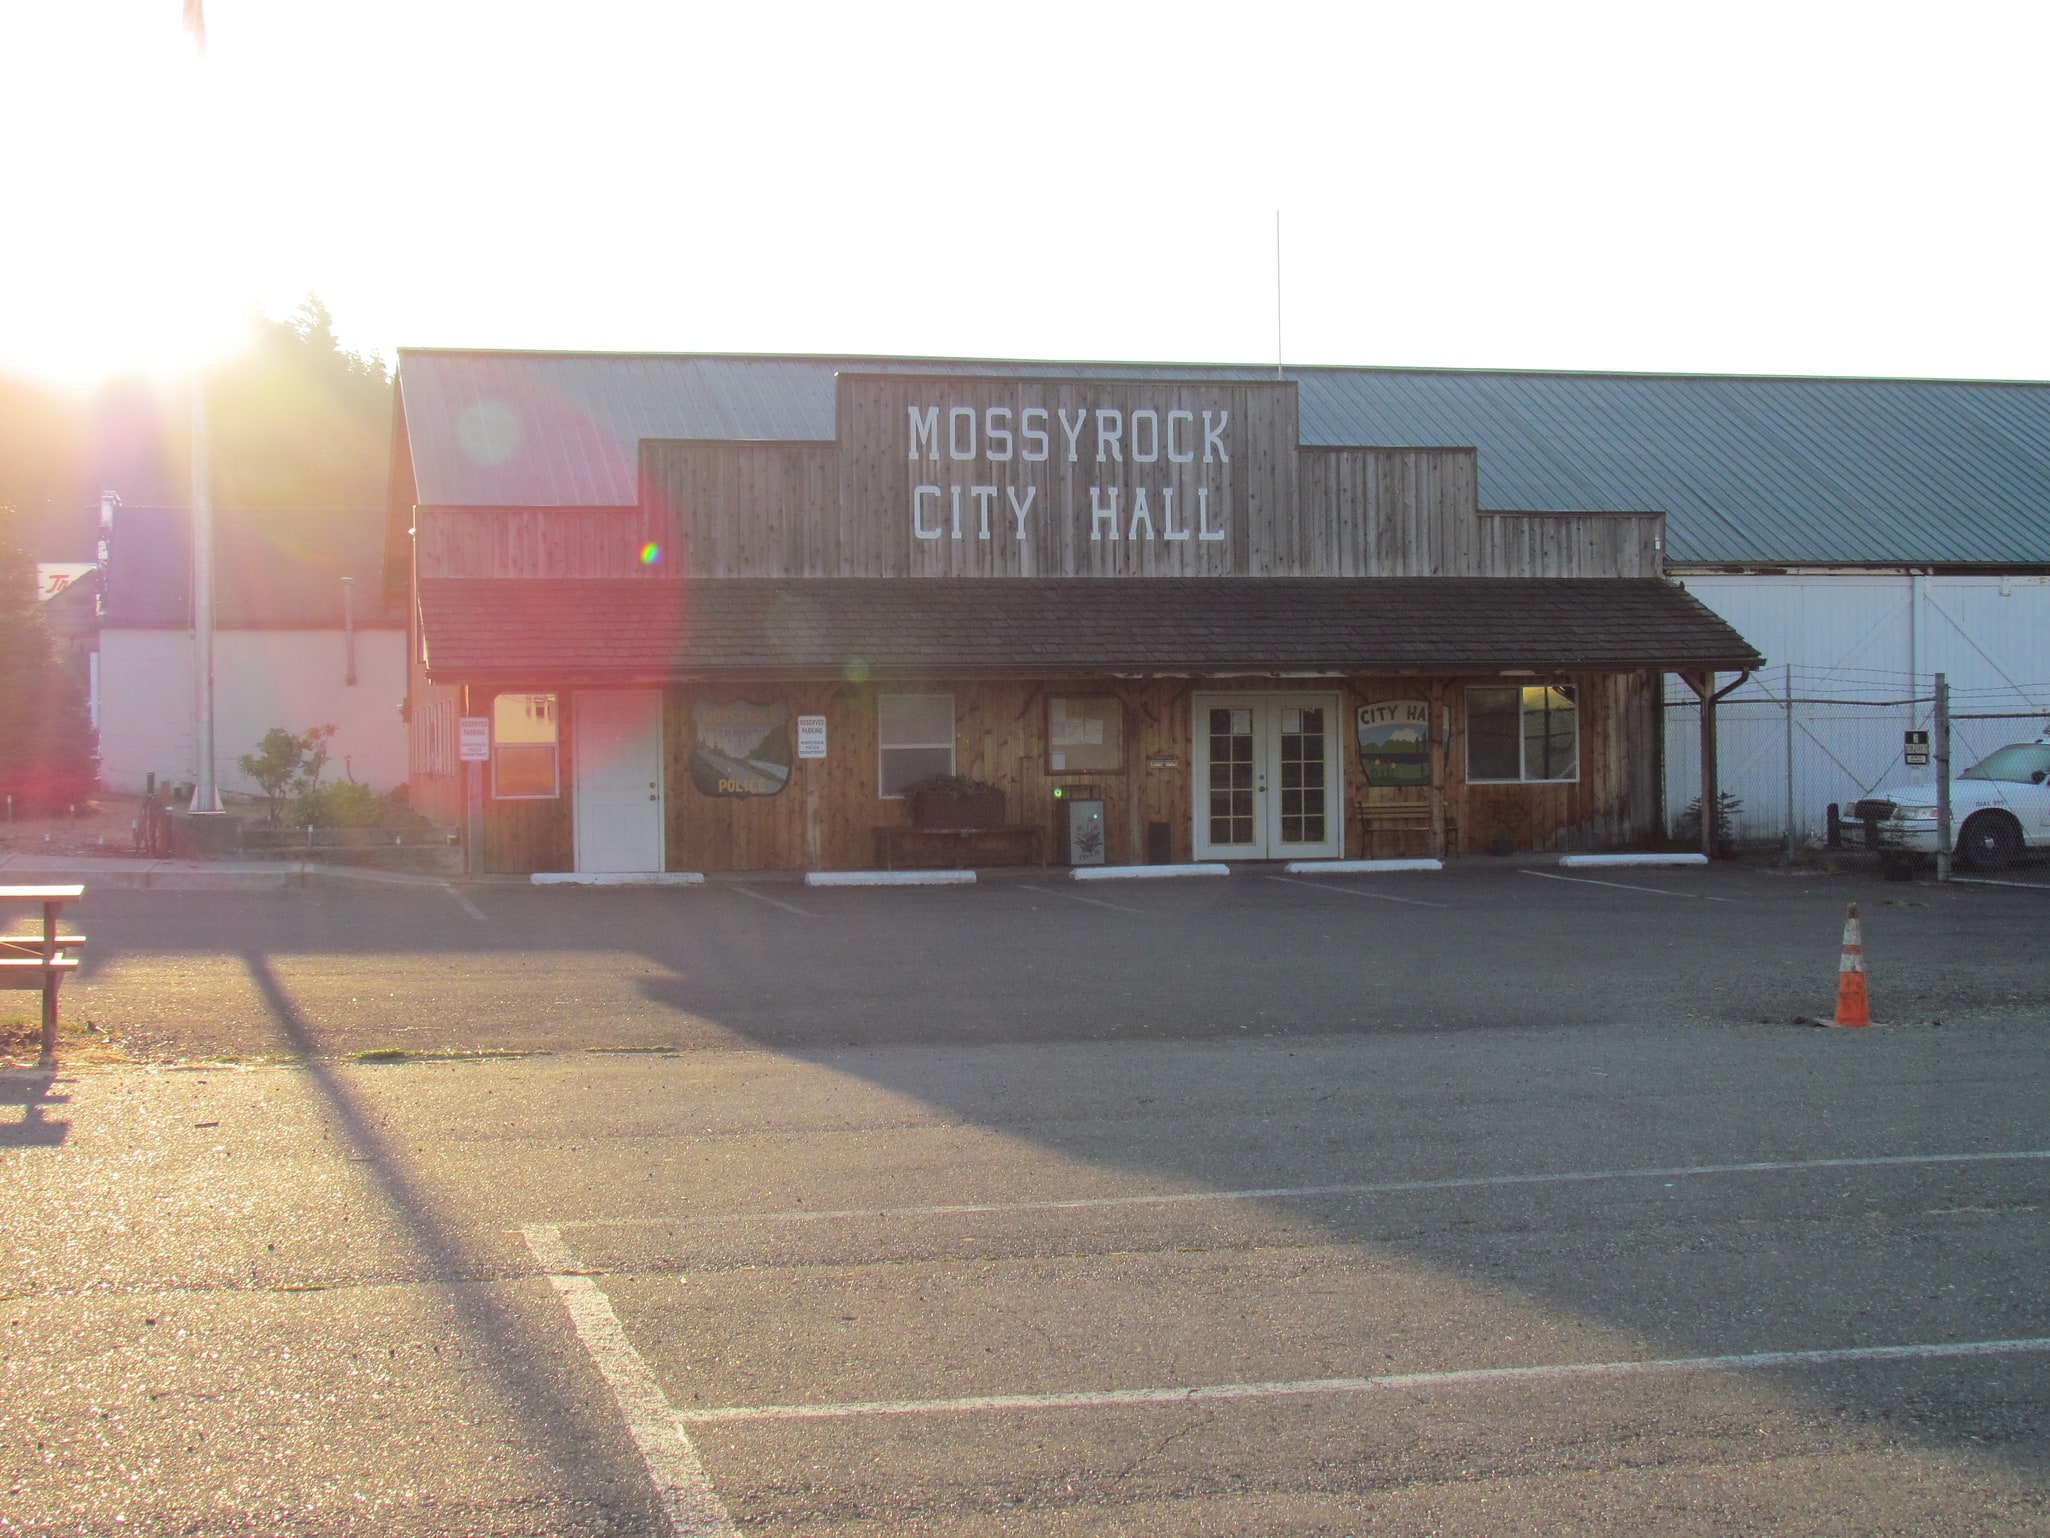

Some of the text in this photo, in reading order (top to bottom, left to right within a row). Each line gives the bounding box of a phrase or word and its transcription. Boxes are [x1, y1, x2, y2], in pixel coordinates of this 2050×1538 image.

[908, 406, 1229, 463] MOSSYROCK
[914, 485, 1225, 541] CITY HALL
[461, 720, 487, 728] RESERVED
[1361, 704, 1426, 724] CITY HA
[719, 778, 766, 792] POLICE
